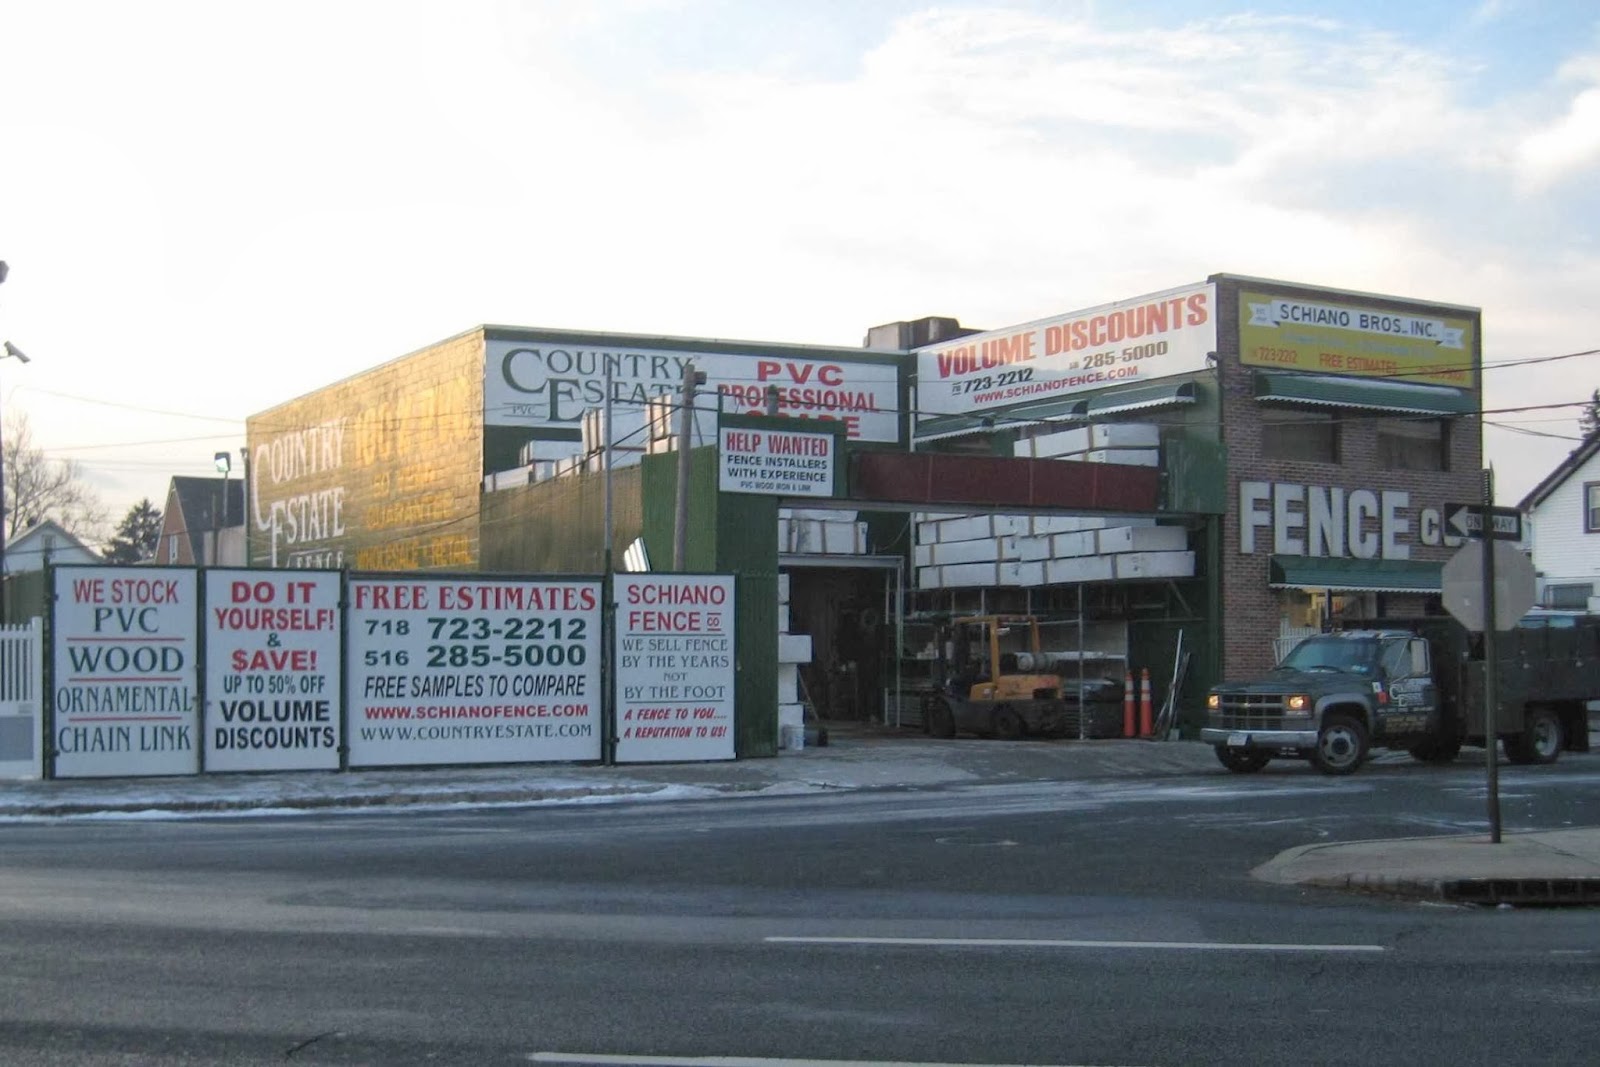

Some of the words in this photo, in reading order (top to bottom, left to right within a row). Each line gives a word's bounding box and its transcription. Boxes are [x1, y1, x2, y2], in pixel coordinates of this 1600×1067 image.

[1280, 304, 1350, 327] SCHIANO
[938, 331, 1037, 379] VOLUME
[1045, 293, 1208, 357] DISCOUNTS
[1083, 341, 1168, 371] 285-5000
[1319, 353, 1344, 369] FREE
[502, 348, 693, 394] COUNTRY
[757, 361, 844, 386] PVC
[963, 367, 1034, 394] 723-2212
[973, 365, 1139, 404] WWW.SCHIANOFENCE.COM
[726, 432, 761, 453] HELP
[768, 435, 828, 457] WANTED
[727, 455, 762, 466] FENCE
[765, 457, 828, 469] INSTALLERS
[254, 416, 348, 532] COUNTRY
[727, 467, 757, 478] WITH
[761, 469, 827, 482] EXPERIENCE
[1240, 481, 1410, 560] FENCE
[73, 579, 104, 603] WE
[112, 579, 179, 604] STOCK
[231, 581, 275, 603] DO
[288, 582, 316, 603] IT
[355, 585, 429, 610] FREE
[438, 586, 596, 611] ESTIMATES
[627, 584, 726, 605] SCHIANO
[94, 607, 159, 633] PVC
[215, 607, 334, 630] YOURSELF!
[365, 619, 410, 635] 718
[427, 617, 586, 640] 723-2212
[629, 611, 701, 631] FENCE
[267, 632, 281, 647] &
[622, 639, 643, 651] WE
[648, 639, 681, 651] SELL
[685, 639, 728, 651] FENCE
[68, 646, 184, 673] WOOD
[364, 650, 410, 666] 516
[426, 644, 587, 668] 285-5000
[622, 655, 641, 668] BY
[646, 655, 676, 668] THE
[681, 655, 730, 668] YEARS
[224, 675, 242, 694] UP
[247, 675, 264, 694] TO
[269, 675, 296, 694] 50%
[301, 675, 325, 694] OFF
[364, 676, 406, 698] FREE
[411, 675, 484, 698] SAMPLES
[489, 675, 508, 697] TO
[512, 674, 586, 697] COMPARE
[663, 672, 688, 681] NOT
[57, 686, 192, 713] ORNAMENTAL
[624, 686, 644, 699] BY
[649, 686, 679, 698] THE
[683, 685, 726, 698] FOOT
[220, 701, 330, 722] VOLUME
[365, 704, 589, 719] WWW.SCHIANOFENCE.COM
[624, 709, 633, 720] A
[637, 708, 671, 720] FENCE
[675, 708, 689, 719] TO
[59, 727, 130, 753] CHAIN
[141, 725, 191, 751] LINK
[215, 726, 335, 749] DISCOUNTS
[361, 723, 592, 741] WWW.COUNTRYESTATE.COM
[624, 727, 632, 738] A
[635, 727, 693, 738] REPUTATION
[696, 727, 708, 738] TO
[710, 726, 727, 737] US!
